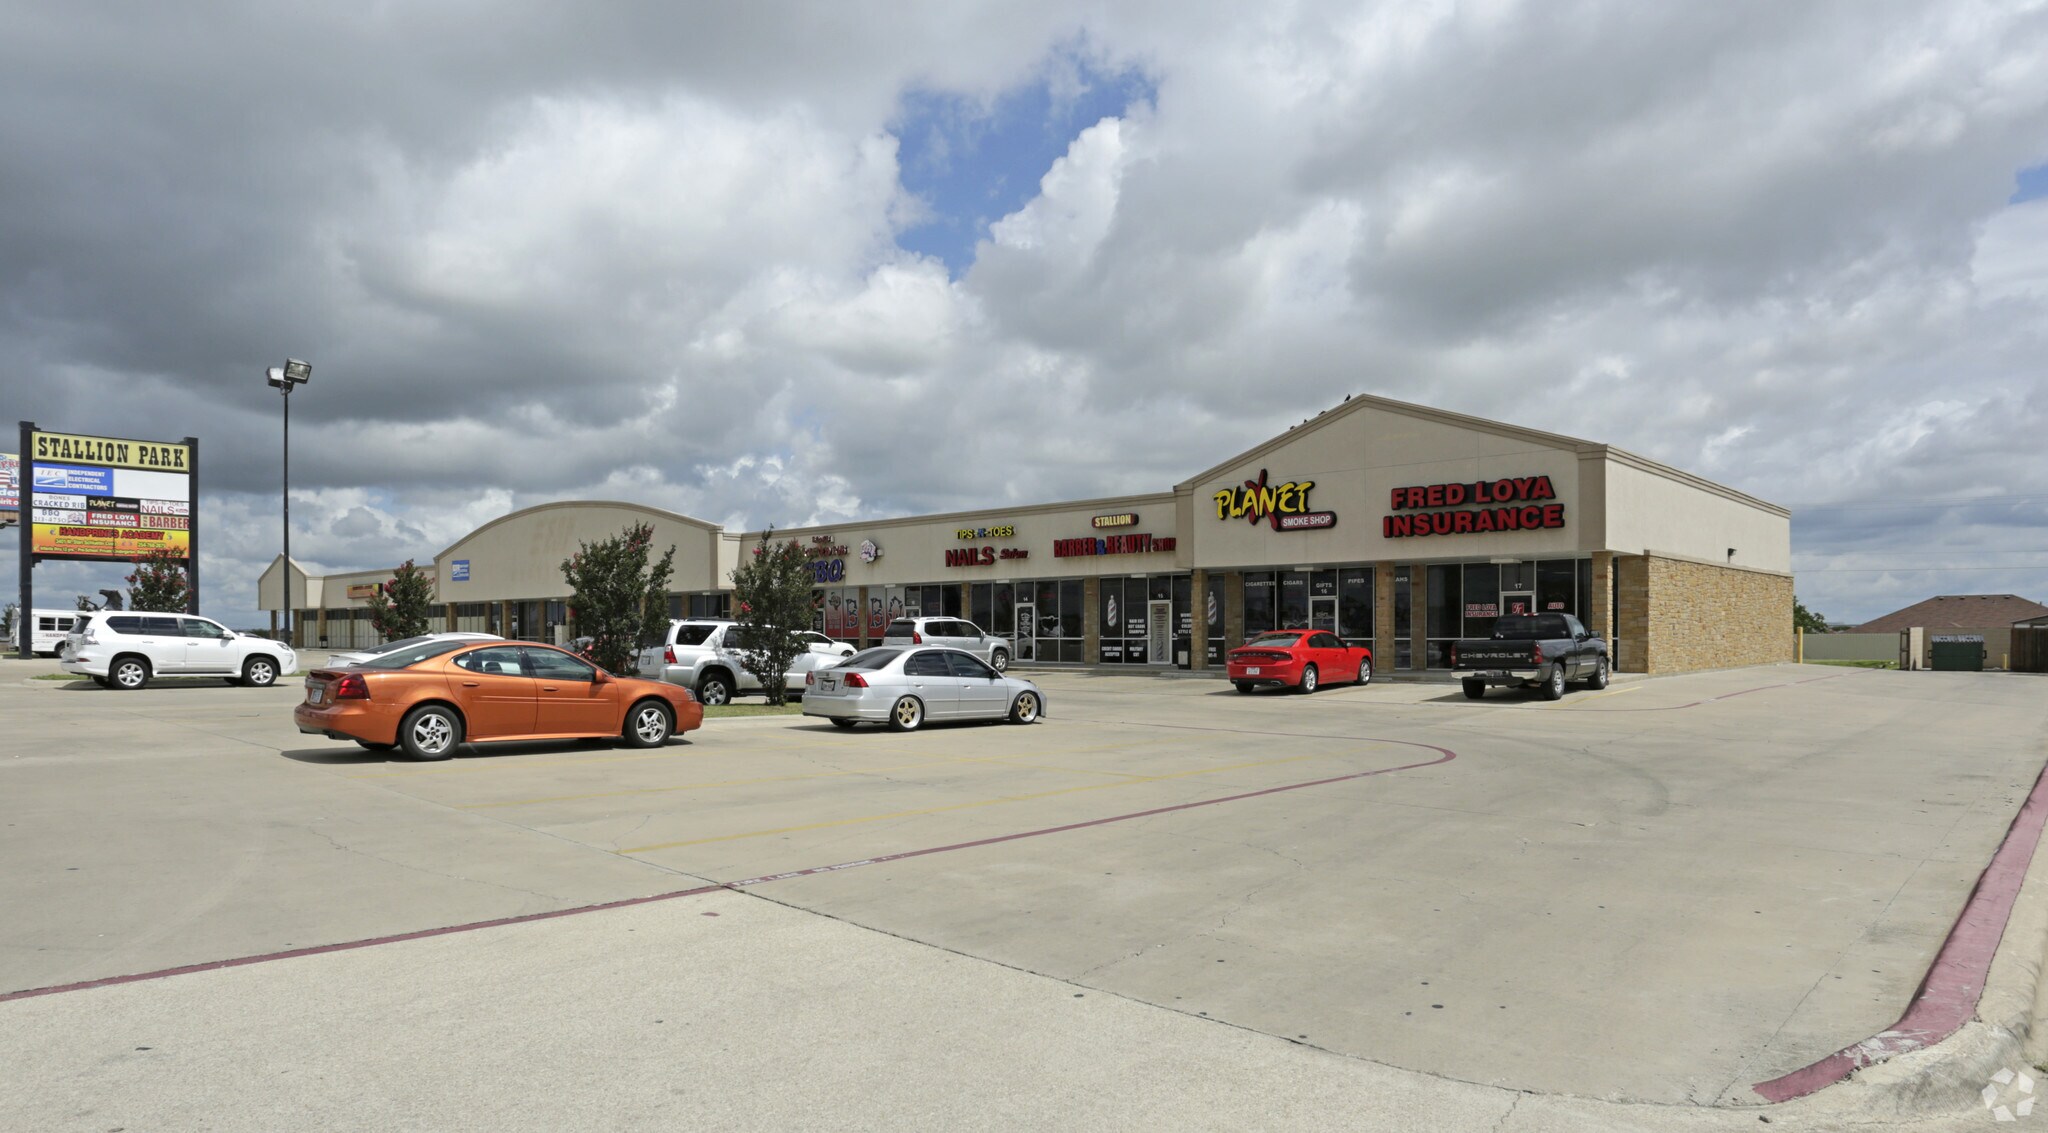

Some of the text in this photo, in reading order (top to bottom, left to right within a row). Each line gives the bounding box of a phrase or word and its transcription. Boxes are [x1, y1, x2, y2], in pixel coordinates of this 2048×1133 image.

[38, 437, 184, 468] STALLION PARK
[68, 469, 106, 477] INDEPENDENT
[68, 476, 101, 484] ELECTRICAL
[1391, 475, 1557, 511] FRED LOYA
[33, 499, 70, 508] CRACKED
[89, 498, 116, 509] PLANET
[1214, 482, 1314, 520] PLANET
[42, 508, 60, 517] BBQ
[92, 512, 113, 520] FRED
[142, 505, 175, 515] NAILS
[90, 519, 138, 527] INSURANCE
[149, 516, 190, 529] BARBER
[1095, 514, 1131, 527] STALLION
[1283, 515, 1331, 527] SMOKE SHOP
[1383, 503, 1565, 538] INSURANCE
[59, 526, 165, 540] HANDPRINTS ACADEMY
[1053, 537, 1097, 558] BARBER
[1106, 533, 1152, 554] BEAUTY
[1152, 537, 1176, 552] SHOP
[945, 546, 995, 567] NAILS
[808, 559, 843, 583] BQ
[1466, 603, 1481, 611] FRED
